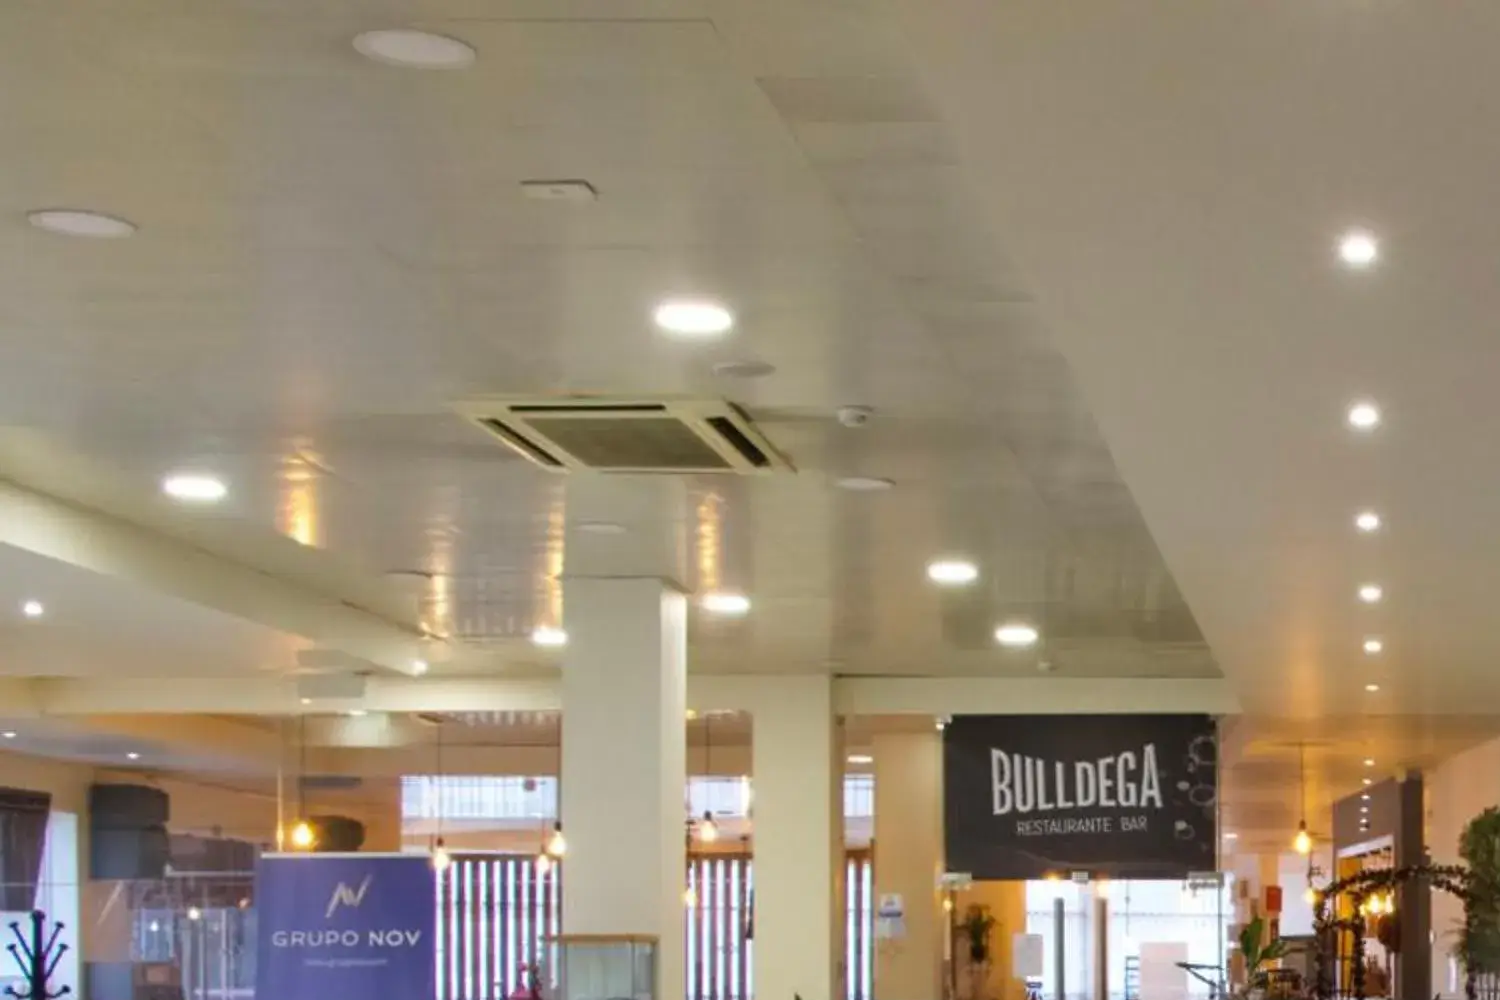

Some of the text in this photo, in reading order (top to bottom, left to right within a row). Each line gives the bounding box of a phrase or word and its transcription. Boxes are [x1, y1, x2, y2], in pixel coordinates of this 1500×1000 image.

[990, 743, 1163, 816] BULLDEGA
[1016, 815, 1148, 836] RESTAURANTE BAR
[271, 930, 421, 947] GRUPO NOV
